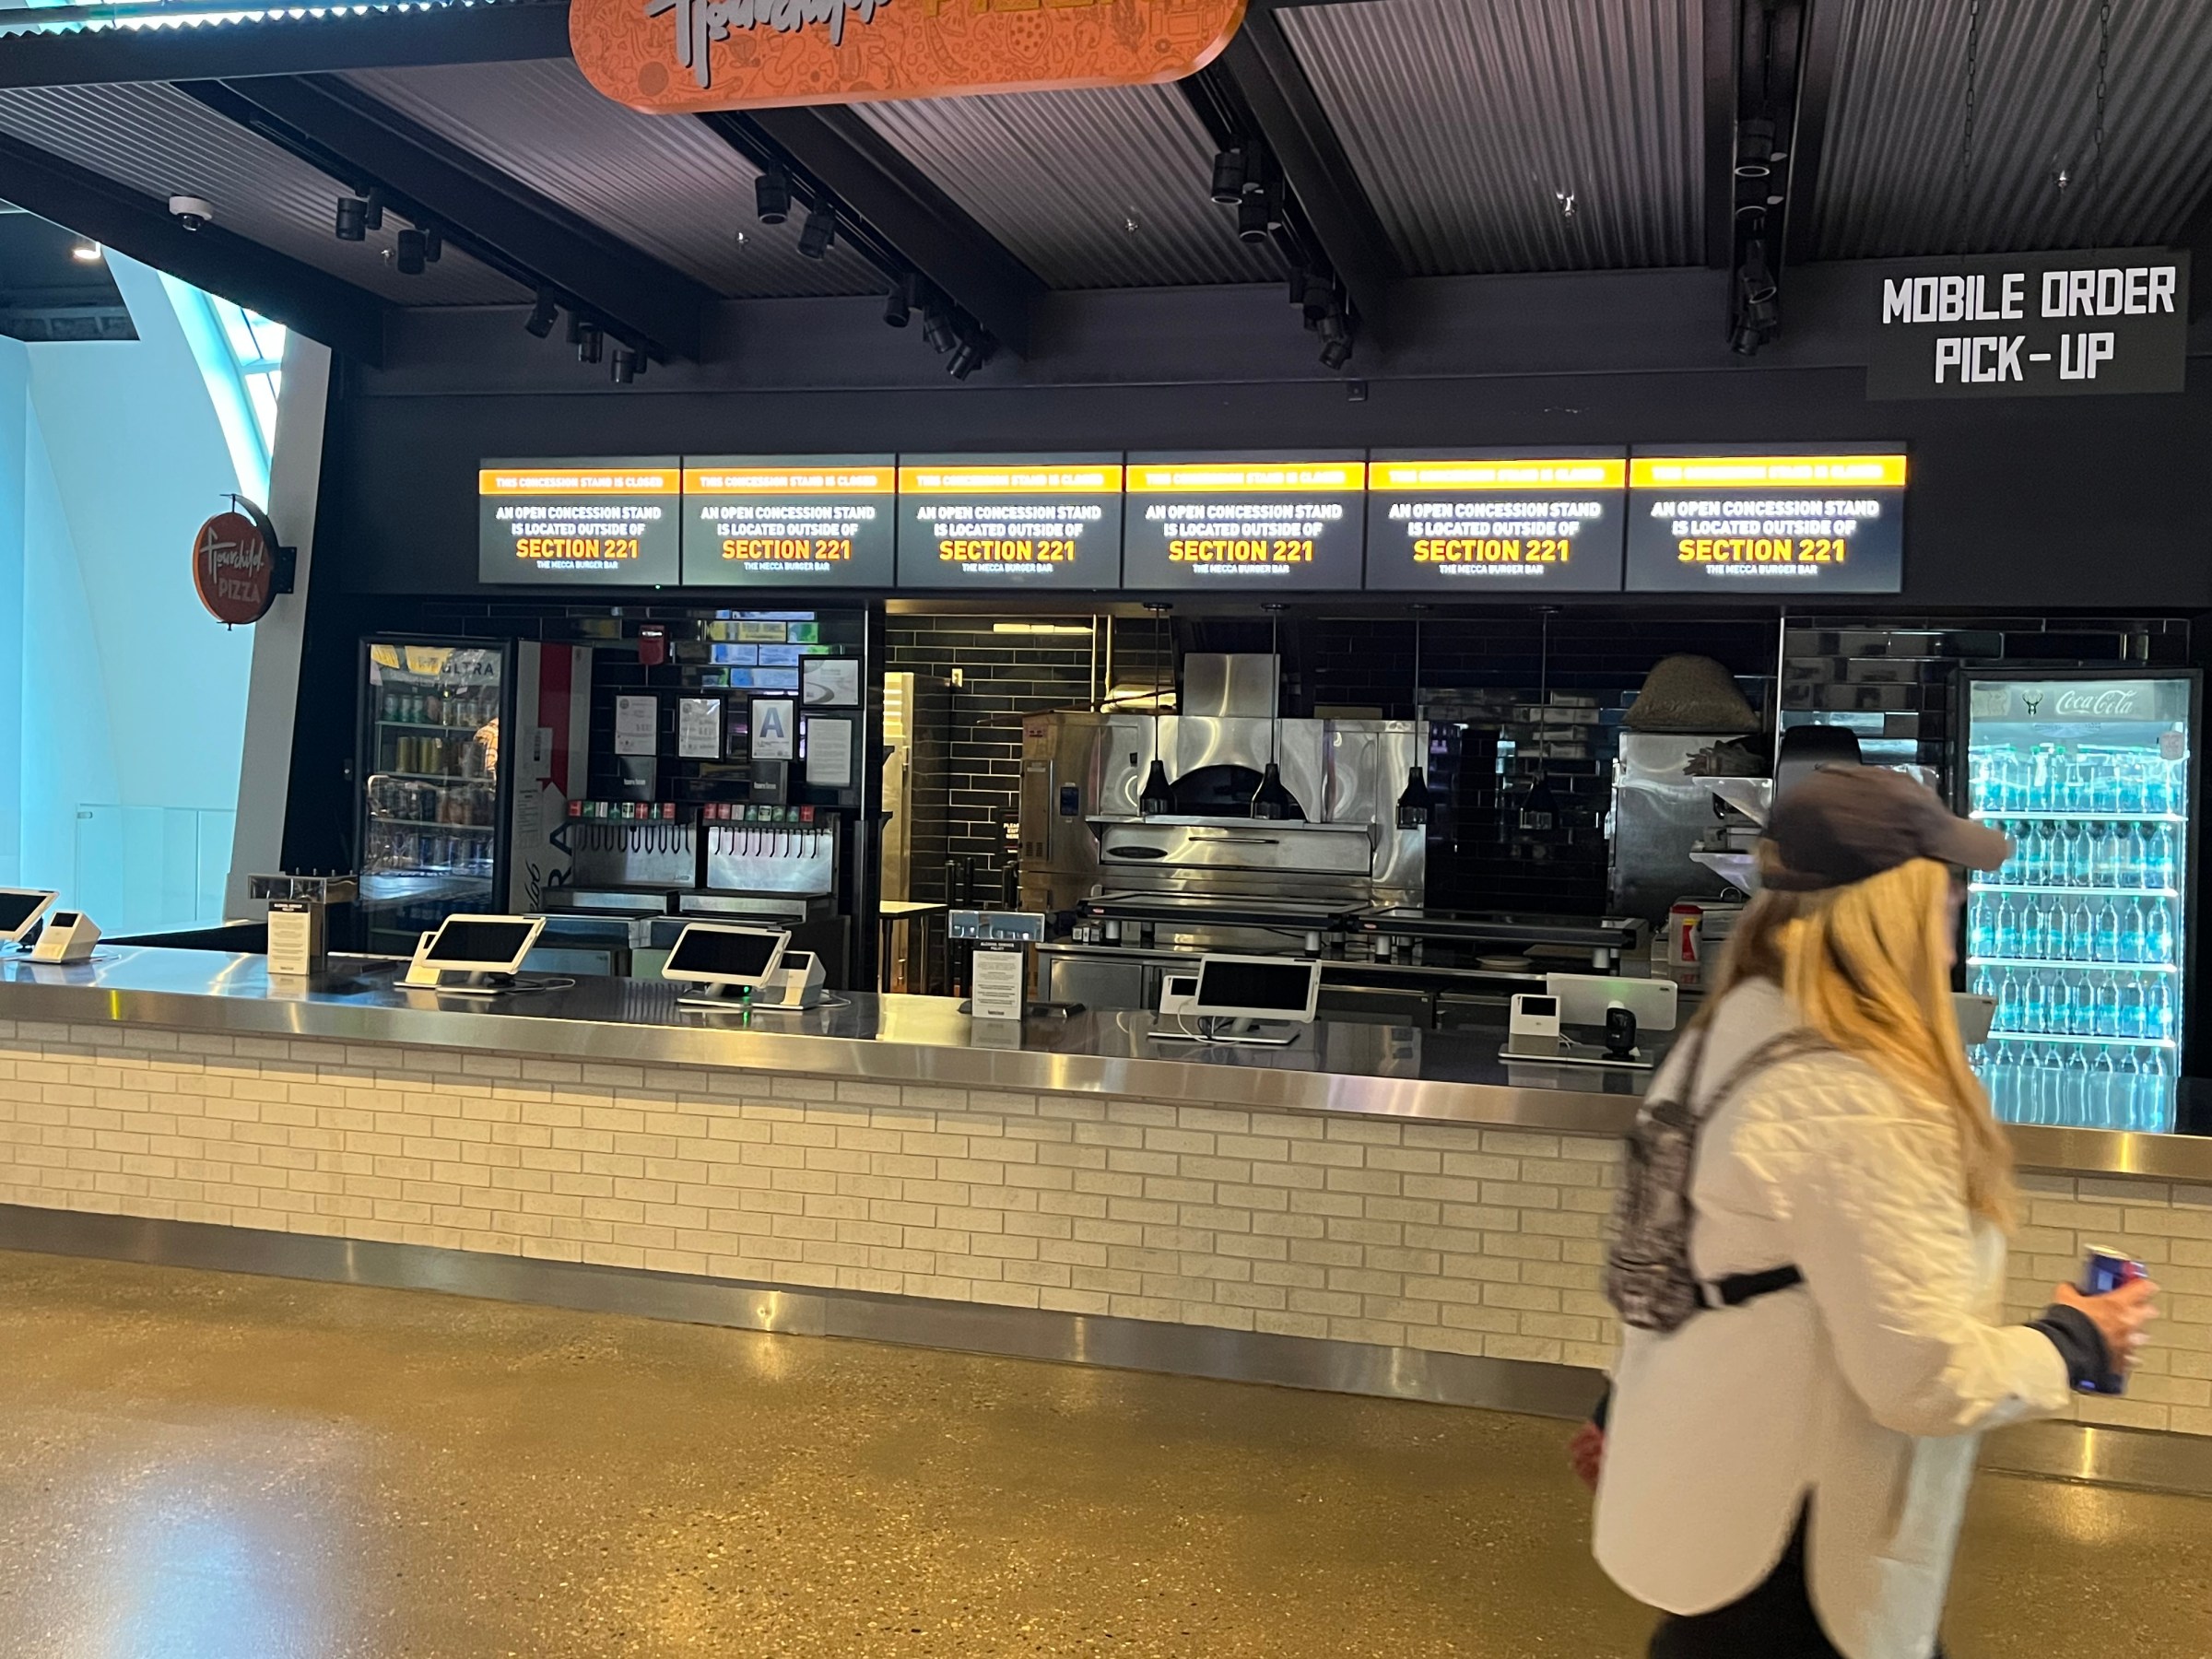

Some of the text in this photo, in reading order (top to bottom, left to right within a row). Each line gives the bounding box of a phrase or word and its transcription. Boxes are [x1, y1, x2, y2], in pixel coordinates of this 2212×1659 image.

[1883, 266, 2176, 324] MOBILE ORDER
[1936, 332, 2114, 383] PICK-UP
[496, 507, 661, 519] AN OPEN CONCESSION STAND
[700, 507, 875, 519] AN OPEN CONCESSION STAND
[917, 506, 1101, 519] AN OPEN CONCESSION STAND
[1146, 504, 1342, 519] AN OPEN CONCESSION STAND
[1389, 502, 1601, 518] AN OPEN CONCESSION STAND
[1652, 500, 1879, 517] AN OPEN CONCESSION STAND
[512, 524, 645, 535] IS LOCATED OUTSIDE OF
[717, 524, 858, 535] IS LOCATED OUTSIDE OF
[935, 524, 1083, 536] IS LOCATED OUTSIDE OF
[1164, 523, 1323, 536] IS LOCATED OUTSIDE OF
[1408, 522, 1579, 535] IS LOCATED OUTSIDE OF
[1672, 520, 1856, 535] IS LOCATED OUTSIDE OF
[516, 539, 638, 558] SECTION 221
[723, 540, 851, 559] SECTION 221
[939, 541, 1075, 560] SECTION 221
[1169, 541, 1312, 561] SECTION 221
[1414, 540, 1569, 560] SECTION 221
[1678, 539, 1845, 560] SECTION 221
[537, 560, 550, 569] THE
[744, 562, 830, 571] THE MECCA BURGER BAR
[962, 563, 1053, 572] THE MECCA BURGER BAR
[1193, 564, 1289, 573] THE MECCA BURGER BAR
[1440, 565, 1544, 574] THE MECCA BURGER BAR
[1706, 565, 1818, 574] THE MECCA BURGER BAR
[218, 578, 261, 604] PIZZA
[2055, 689, 2136, 714] Coca-Cola
[759, 707, 784, 738] A
